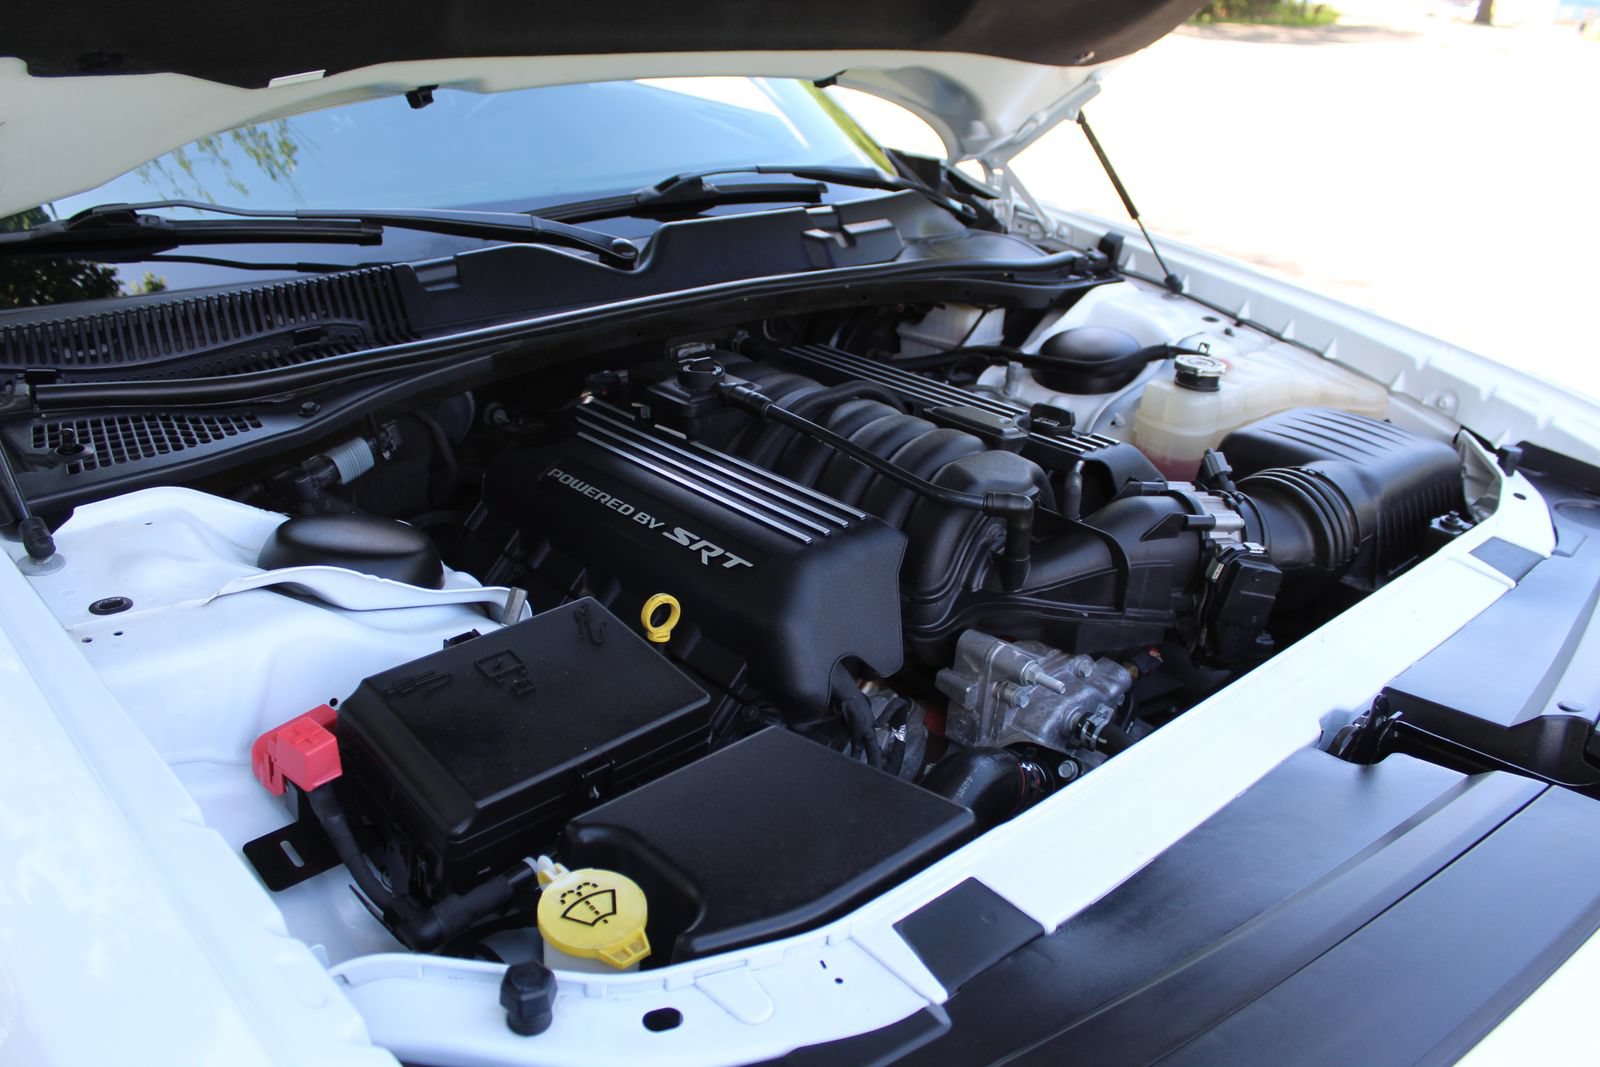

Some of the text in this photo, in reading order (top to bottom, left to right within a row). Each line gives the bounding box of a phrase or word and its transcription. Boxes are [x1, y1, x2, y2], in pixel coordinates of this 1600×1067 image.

[547, 468, 754, 569] POWERED BY SRT
